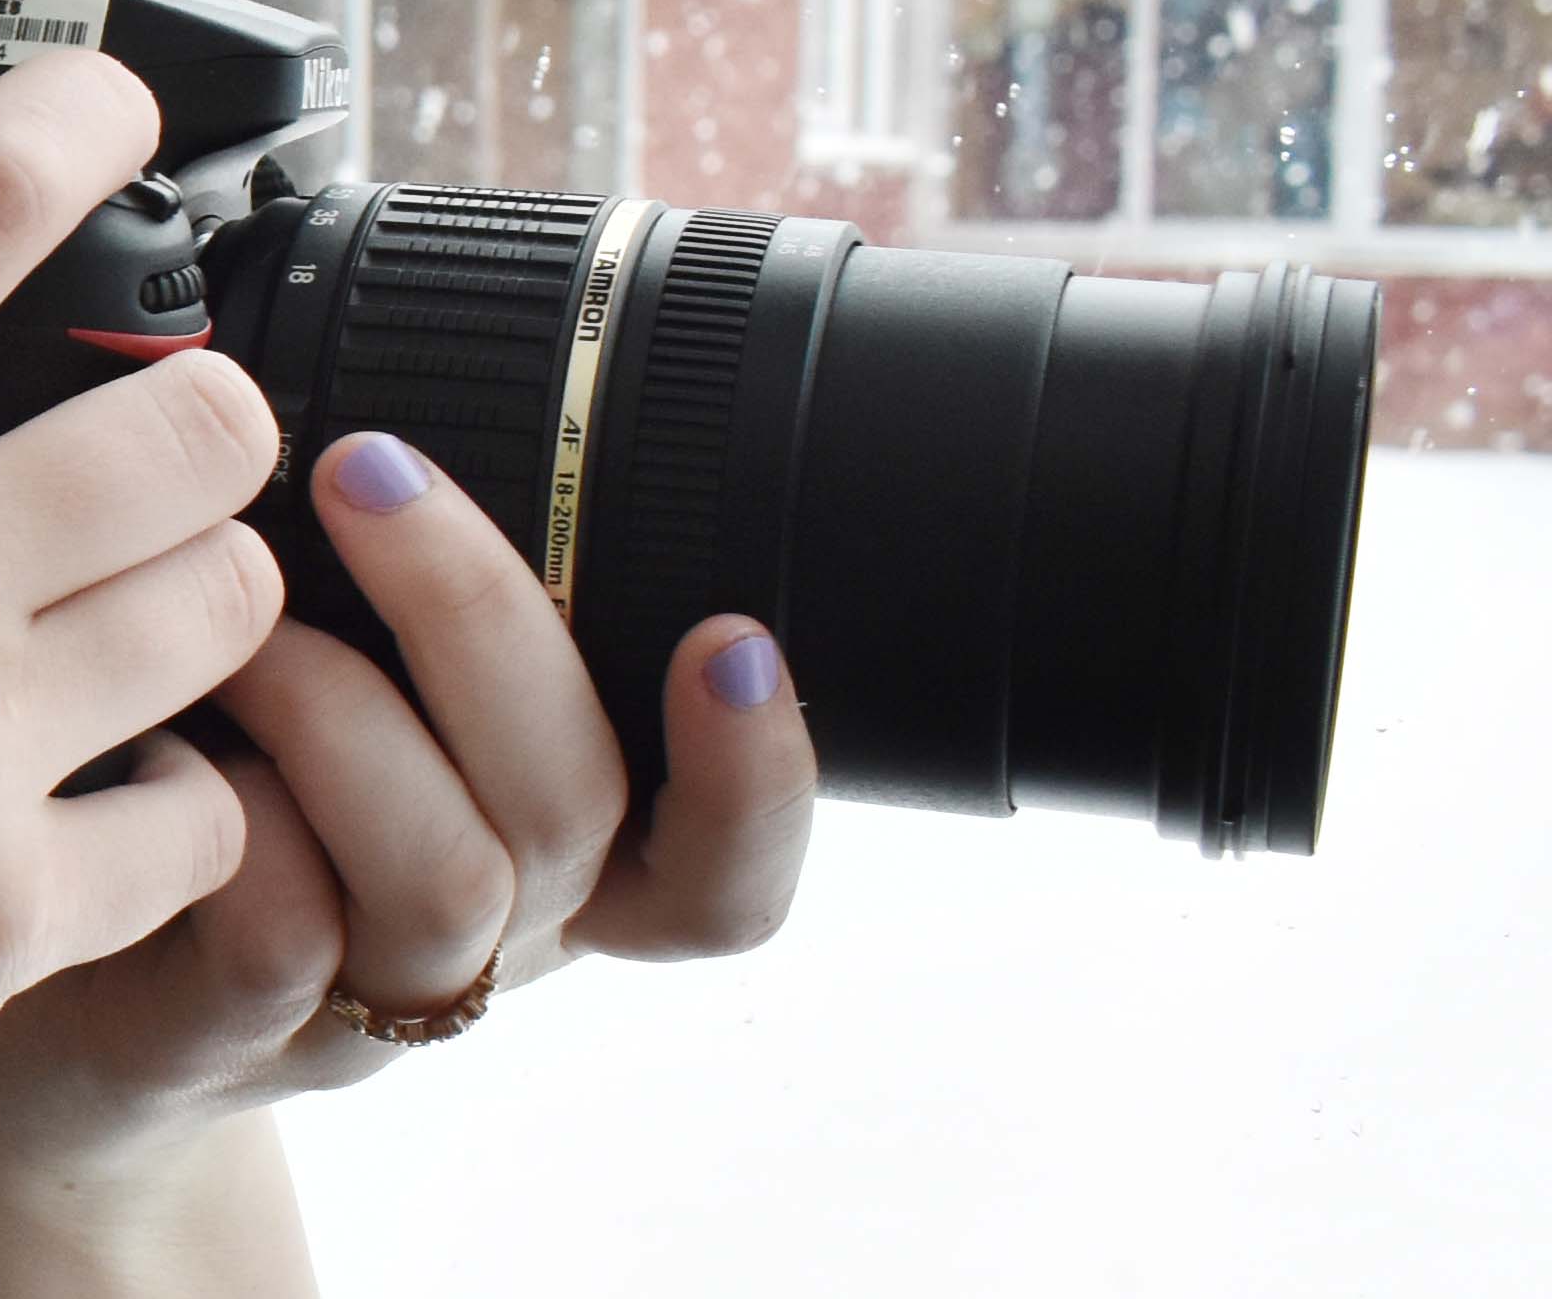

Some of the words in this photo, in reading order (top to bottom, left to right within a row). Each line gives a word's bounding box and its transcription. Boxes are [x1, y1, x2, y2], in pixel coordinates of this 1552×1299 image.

[309, 208, 339, 227] 35
[288, 263, 317, 284] 18
[561, 413, 582, 455] AF
[548, 472, 575, 585] 18-200mm
